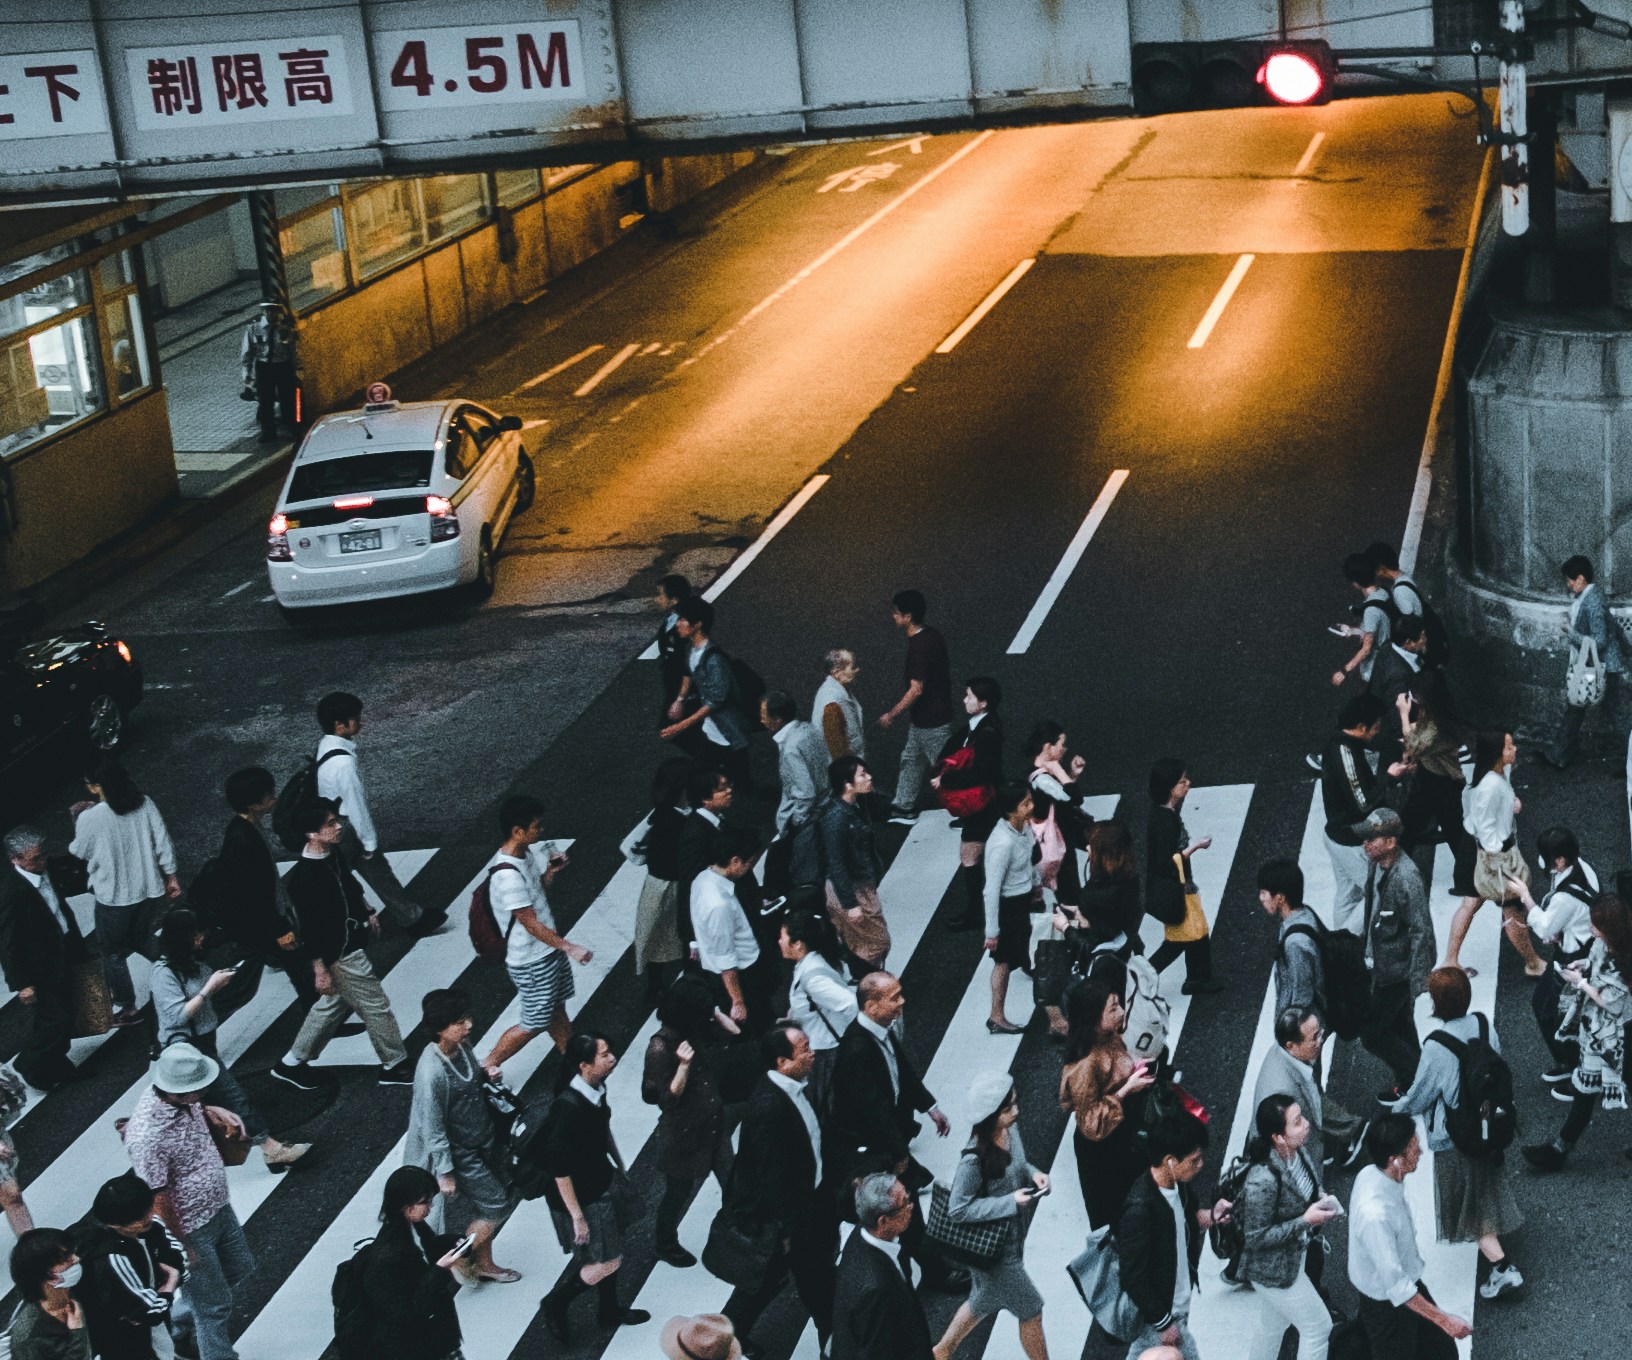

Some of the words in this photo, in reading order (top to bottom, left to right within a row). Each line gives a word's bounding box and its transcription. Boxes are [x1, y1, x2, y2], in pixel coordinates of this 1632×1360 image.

[147, 49, 334, 115] 制限高
[391, 32, 571, 97] 4.5M
